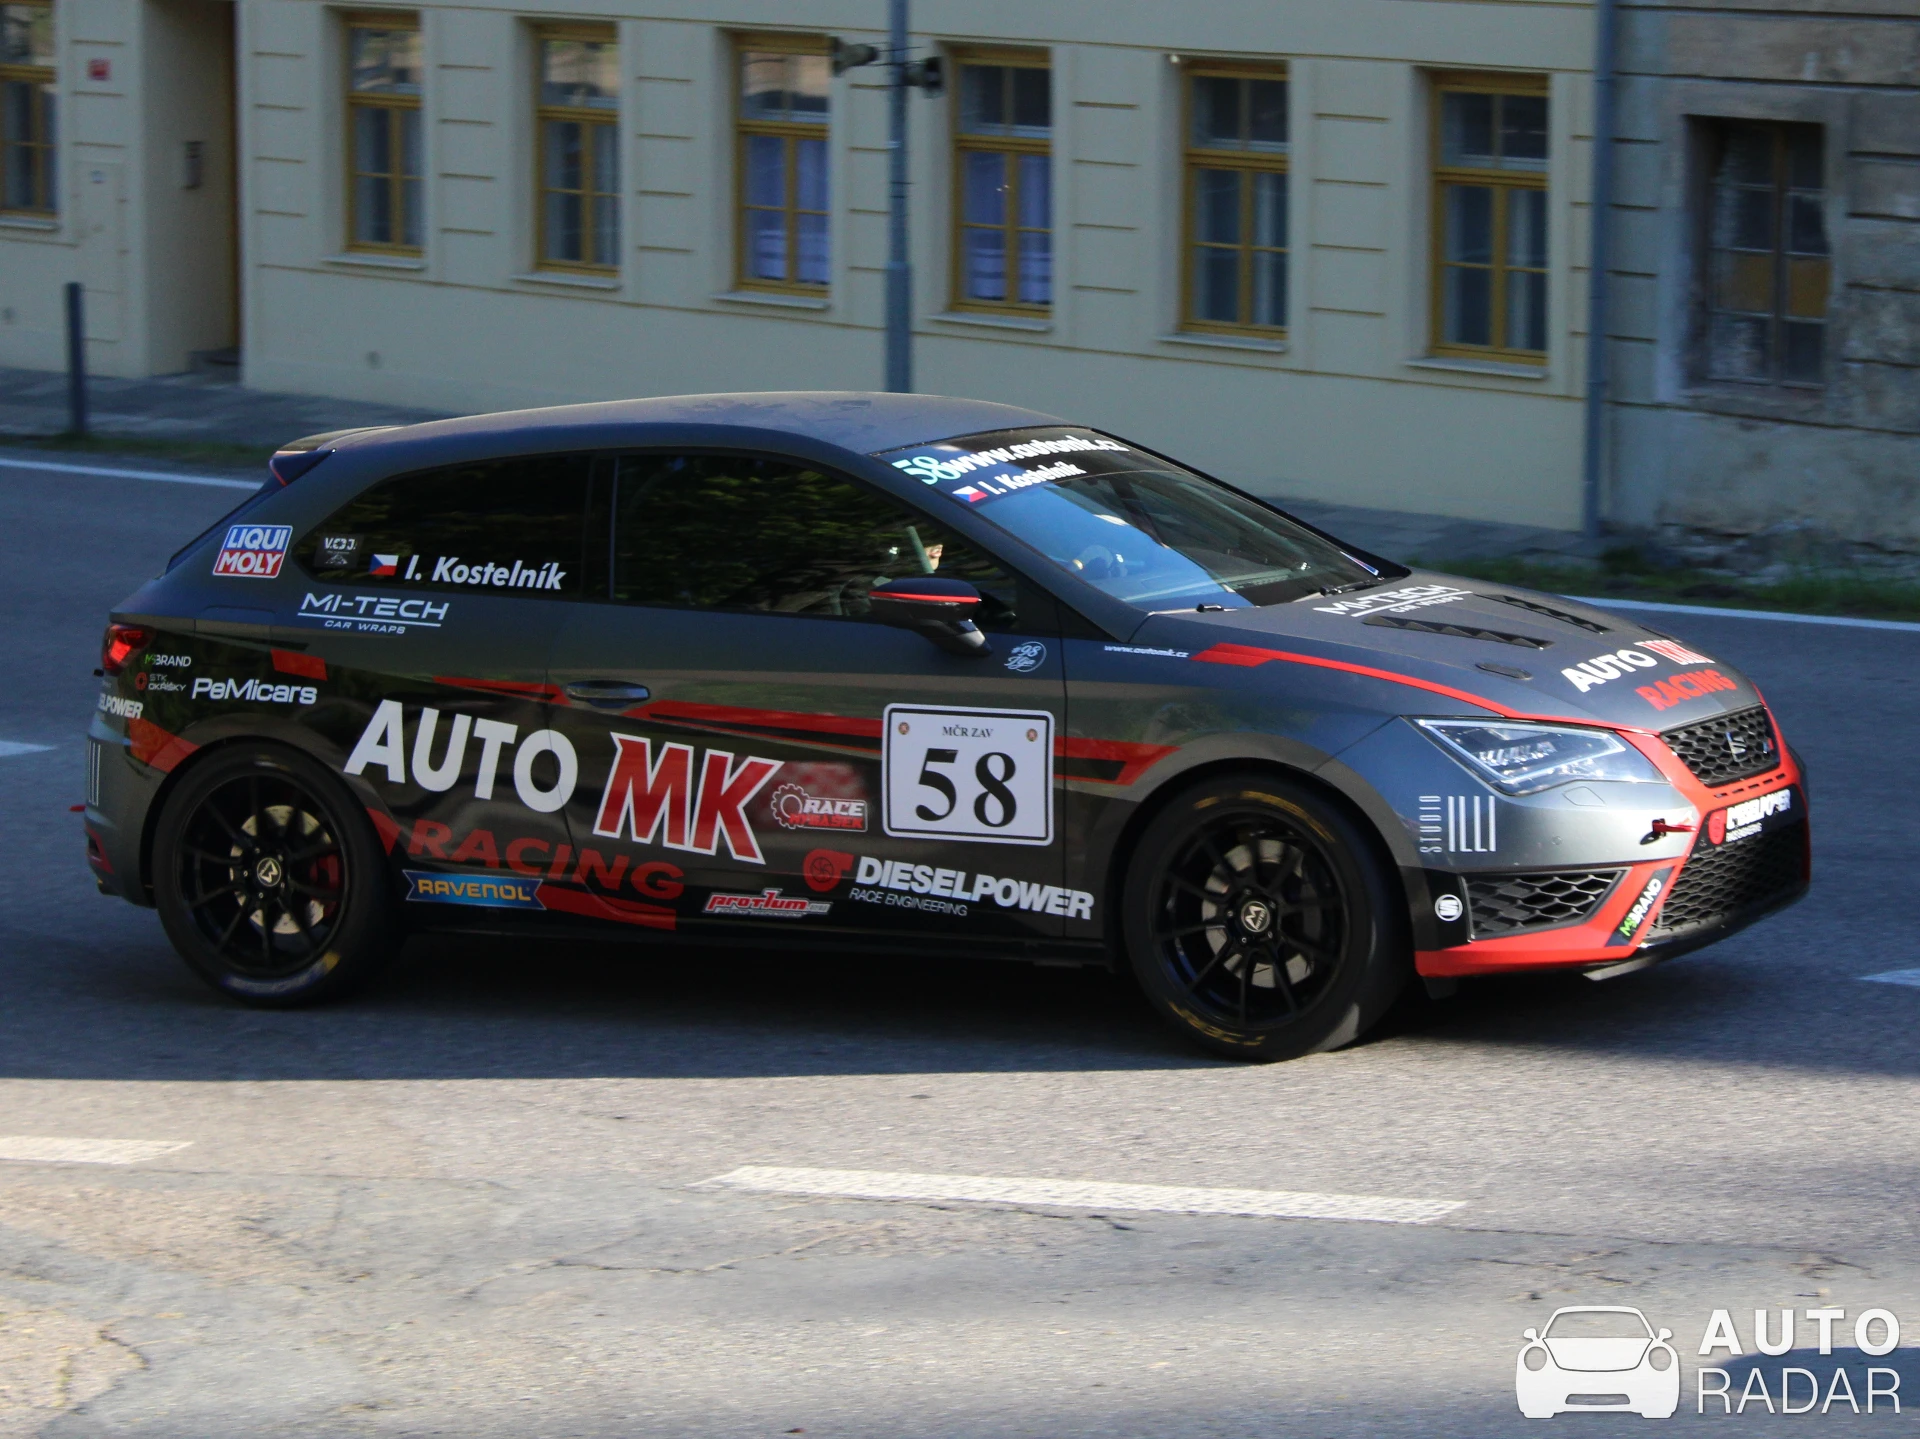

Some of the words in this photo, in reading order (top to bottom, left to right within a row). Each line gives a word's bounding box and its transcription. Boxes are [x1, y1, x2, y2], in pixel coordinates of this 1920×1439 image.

[226, 528, 288, 551] LIQUI
[217, 551, 282, 575] MOLY
[404, 554, 422, 581] I.
[432, 556, 567, 590] Kostelník
[300, 592, 450, 621] MI-TECH
[324, 619, 352, 629] CAR
[358, 623, 406, 635] WRAPS
[1560, 650, 1658, 693] AUTO
[191, 678, 318, 705] PeMicars
[1635, 669, 1738, 712] RACING
[942, 724, 969, 737] MČR
[971, 727, 994, 738] ZAV
[343, 699, 579, 813] AUTO
[592, 731, 786, 865] MK
[915, 747, 1018, 828] 58
[803, 799, 865, 817] RACE
[1418, 795, 1443, 853] STUDIO
[406, 818, 685, 900] RACING
[417, 879, 532, 902] RAVENOL
[849, 887, 885, 904] RACE
[884, 893, 969, 917] ENGINEERING
[855, 856, 1095, 920] DIESELPOWER
